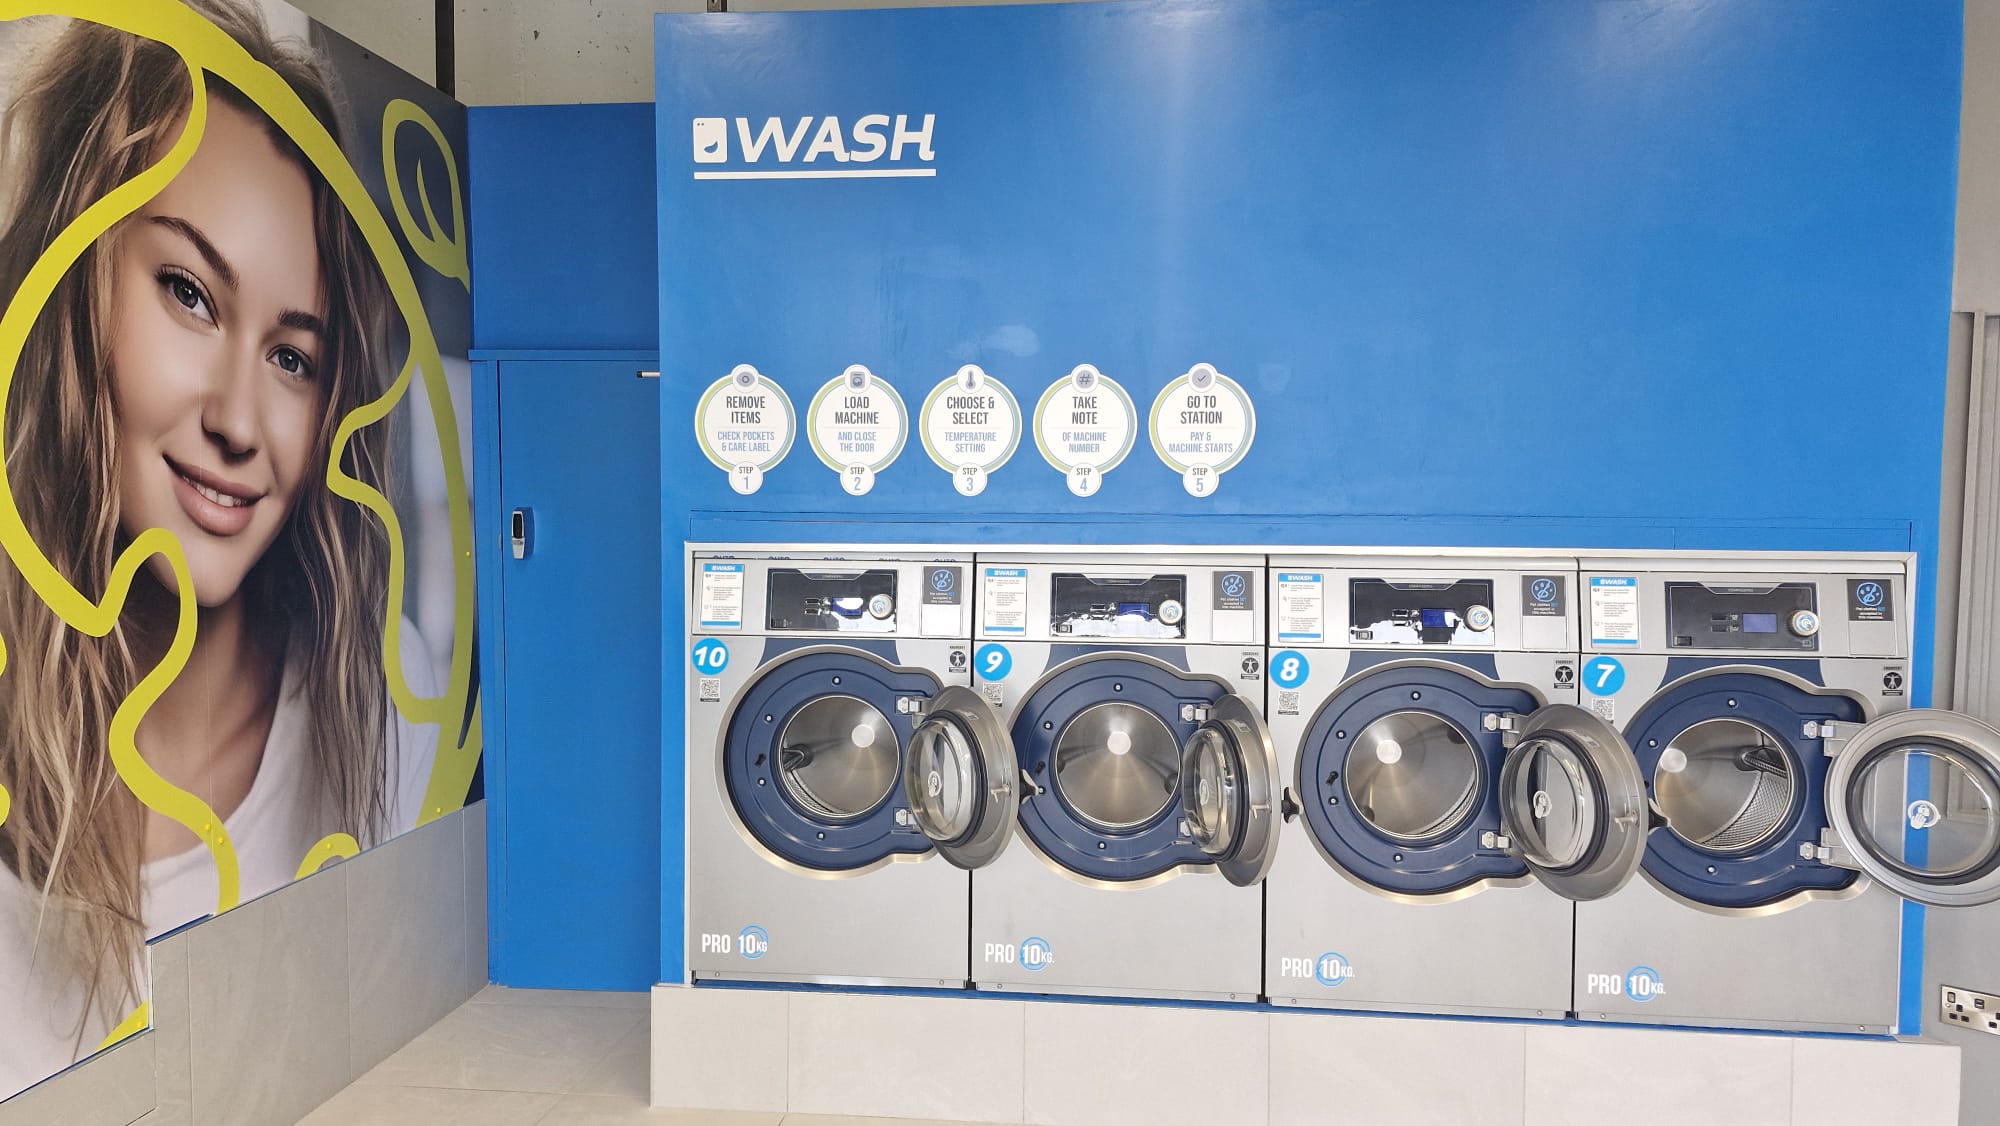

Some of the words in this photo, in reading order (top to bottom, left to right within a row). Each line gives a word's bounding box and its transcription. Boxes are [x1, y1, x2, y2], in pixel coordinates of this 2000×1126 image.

[735, 113, 936, 162] WASH
[726, 395, 766, 409] REMOVE
[844, 396, 869, 409] LOAD
[947, 396, 985, 409] CHOOSE
[988, 396, 994, 409] &
[1072, 396, 1097, 409] TAKE
[1187, 395, 1201, 409] GO
[1204, 395, 1216, 409] TO
[731, 411, 761, 424] ITEMS
[835, 411, 879, 425] MACHINE
[952, 412, 989, 425] SELECT
[1071, 411, 1098, 425] NOTE
[1180, 411, 1222, 424] STATION
[717, 431, 741, 441] CHECK
[743, 431, 775, 441] POCKETS
[837, 431, 852, 441] AND
[854, 431, 877, 441] CLOSE
[944, 431, 997, 442] TEMPERATURE
[1062, 431, 1072, 442] OF
[1073, 431, 1107, 442] MACHINE
[1190, 431, 1204, 442] PAY
[1206, 431, 1212, 442] &
[721, 442, 727, 452] &
[728, 442, 747, 452] CARE
[748, 442, 771, 452] LABEL
[840, 442, 853, 452] THE
[855, 442, 875, 452] DOOR
[955, 443, 985, 453] SETTING
[1069, 443, 1100, 453] NUMBER
[1168, 443, 1203, 453] MACHINE
[1204, 443, 1233, 453] STARTS
[738, 466, 754, 474] STEP
[850, 466, 865, 475] STEP
[962, 467, 978, 475] STEP
[1076, 467, 1091, 476] STEP
[1192, 467, 1208, 476] STEP
[743, 475, 749, 490] 1
[854, 476, 861, 491] 2
[966, 477, 973, 491] 3
[1080, 477, 1087, 492] 4
[1196, 477, 1204, 492] 5
[695, 646, 726, 668] 10
[985, 651, 1003, 673] 9
[1279, 657, 1300, 681] 8
[1596, 663, 1616, 688] 7
[702, 933, 731, 954] PRO
[985, 943, 1015, 964] PRO
[1281, 957, 1313, 978] PRO
[1587, 973, 1622, 995] PRO
